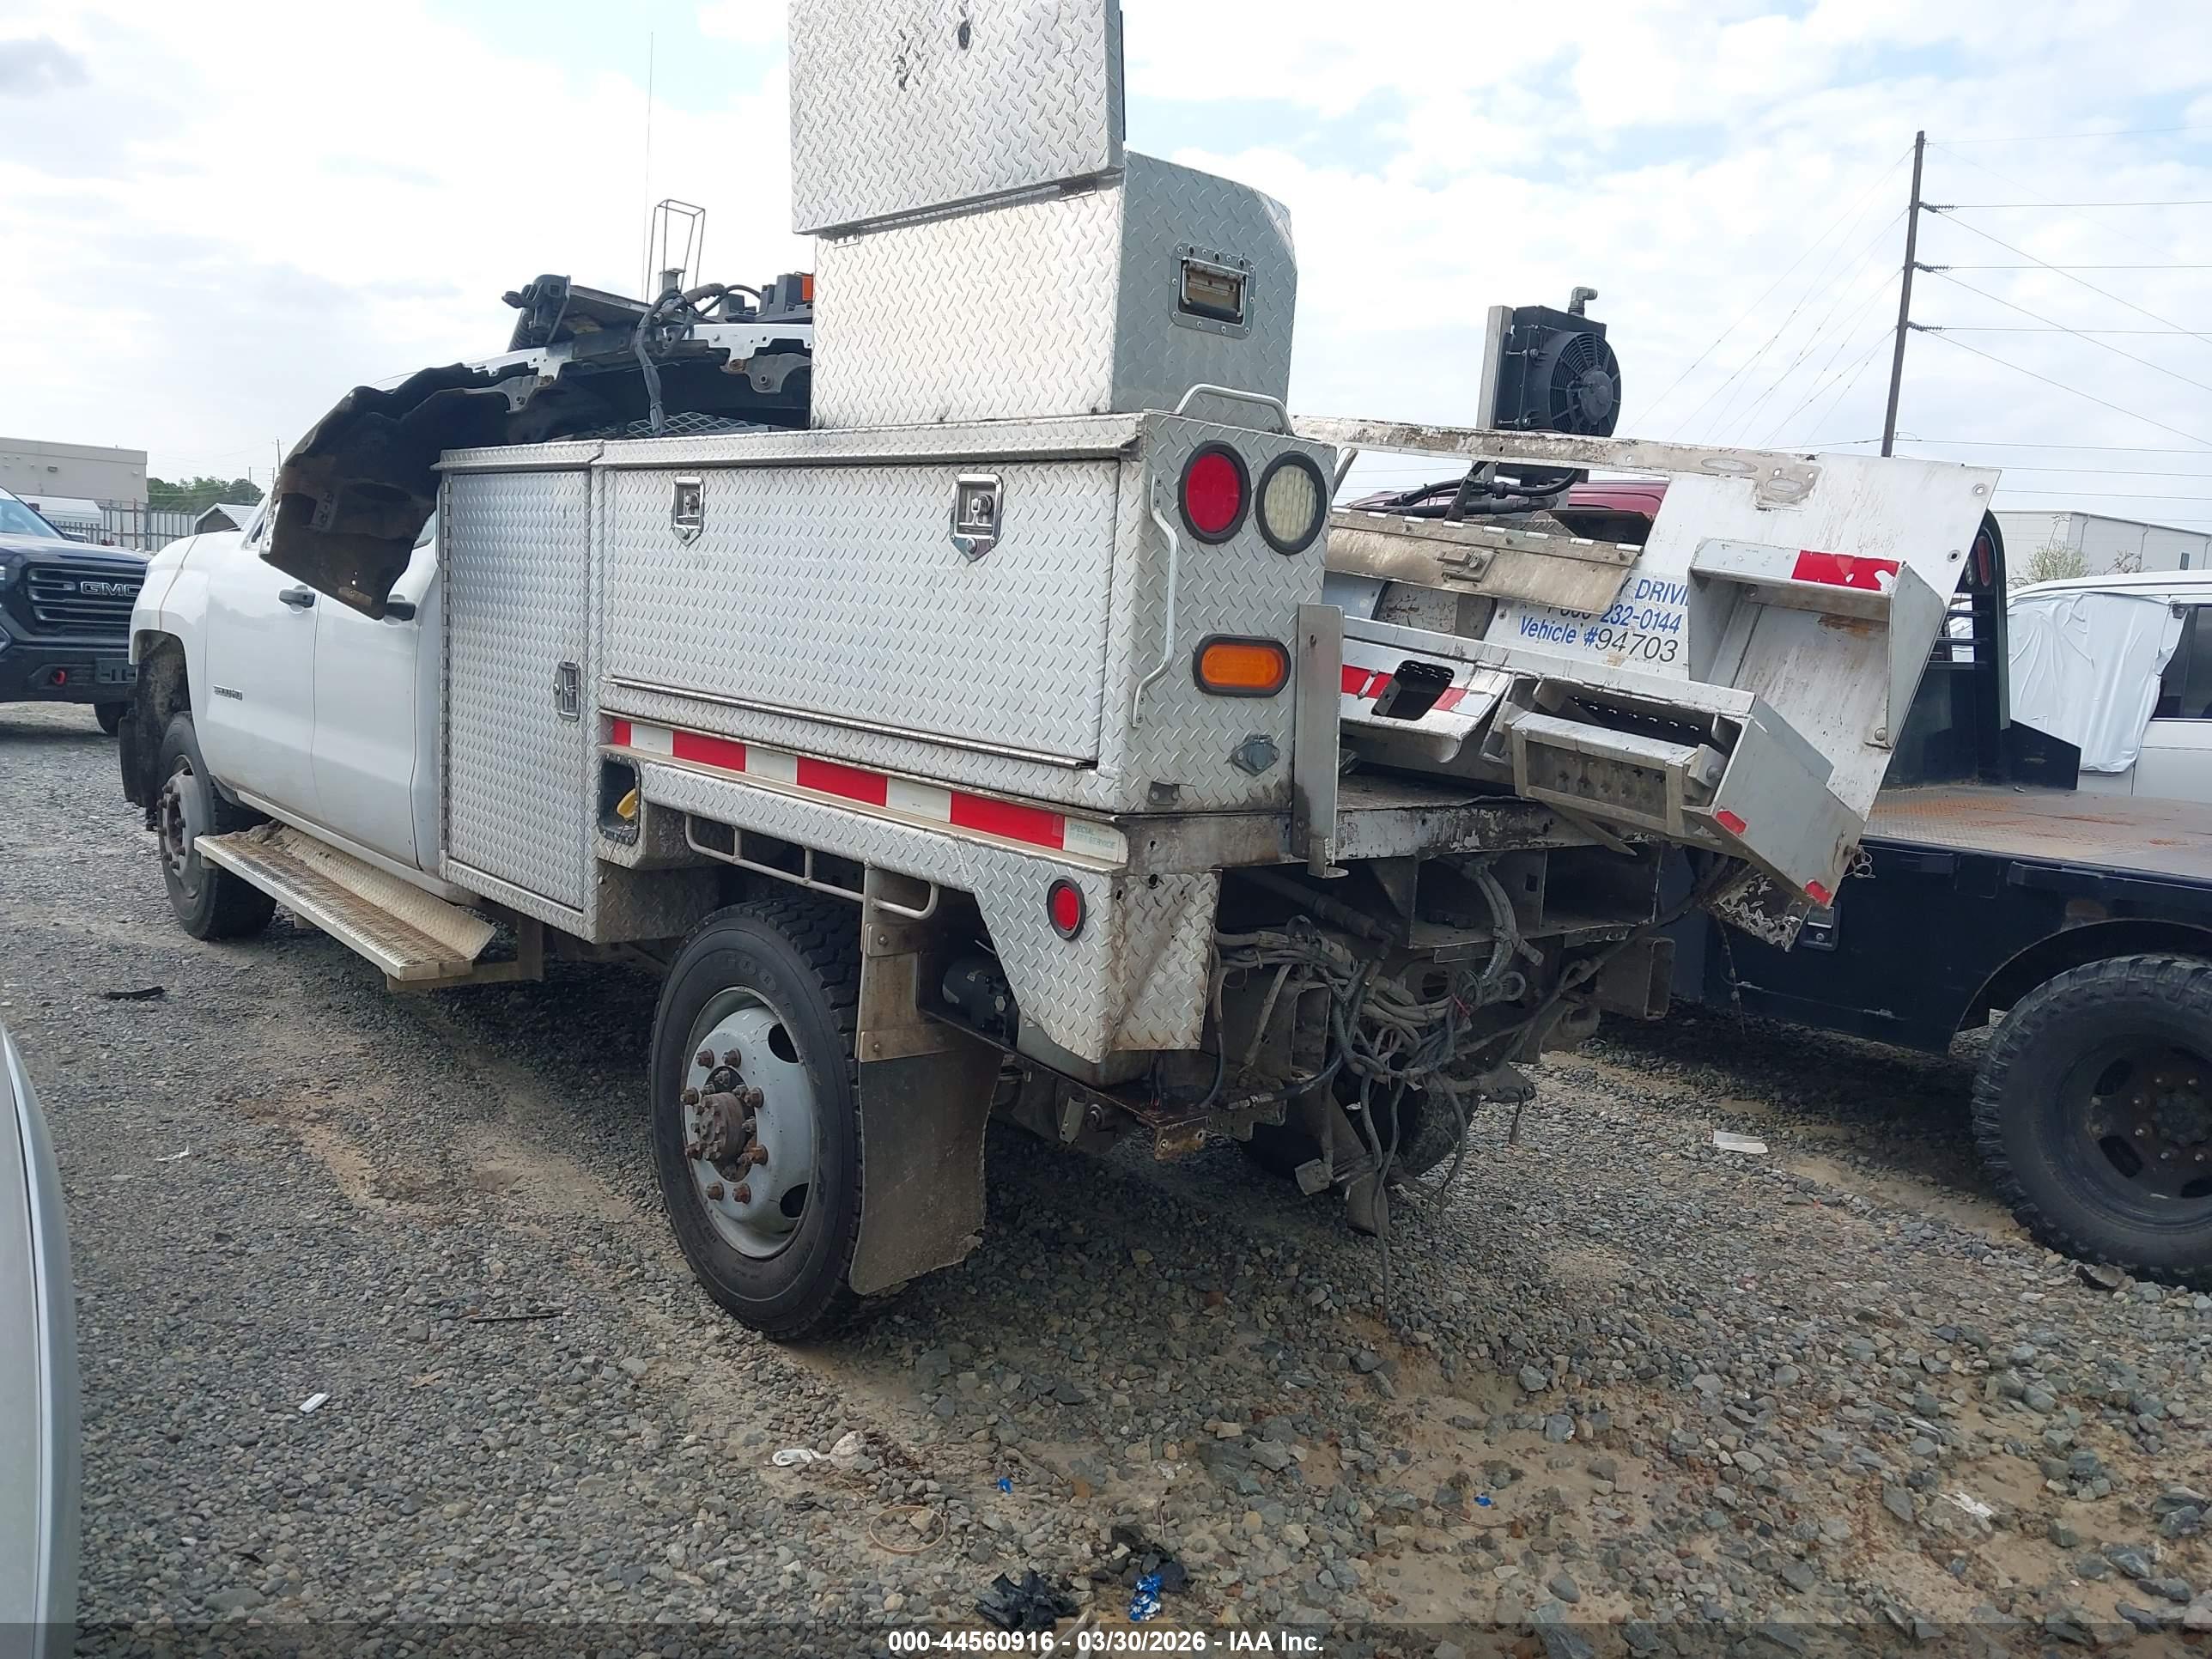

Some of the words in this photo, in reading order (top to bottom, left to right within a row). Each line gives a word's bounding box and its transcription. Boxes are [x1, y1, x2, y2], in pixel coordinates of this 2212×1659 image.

[81, 581, 142, 597] GMC
[1520, 616, 1577, 644] Vehicle
[1583, 626, 1679, 663] #94703
